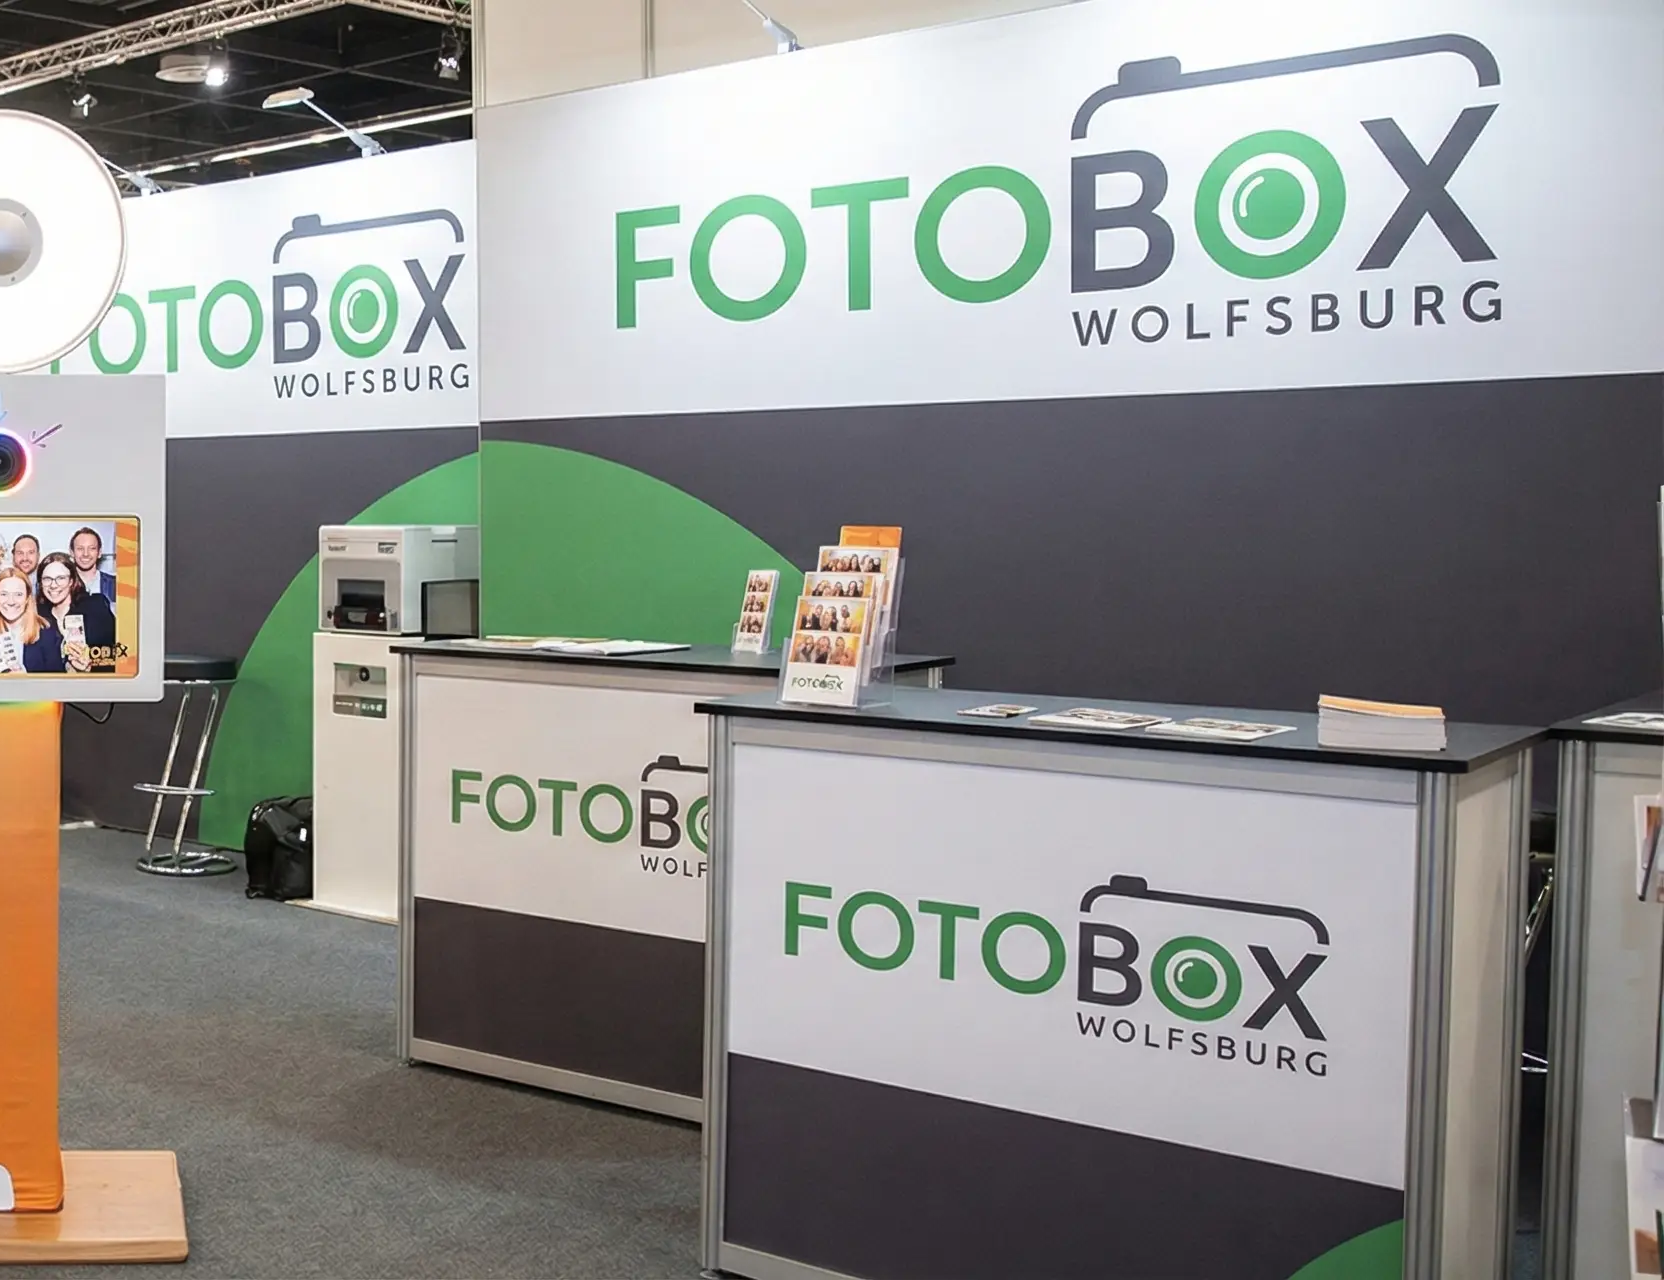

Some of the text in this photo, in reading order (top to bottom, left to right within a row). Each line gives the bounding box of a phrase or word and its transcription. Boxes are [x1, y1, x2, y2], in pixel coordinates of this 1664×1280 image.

[616, 103, 1500, 330] FOTOBOX
[50, 254, 468, 375] OTOBOX
[1072, 280, 1504, 346] WOLFSBURG
[273, 363, 471, 399] WOLFSBURG
[784, 880, 1329, 1042] FOTOBOX
[1076, 1012, 1329, 1077] WOLFSBURG
